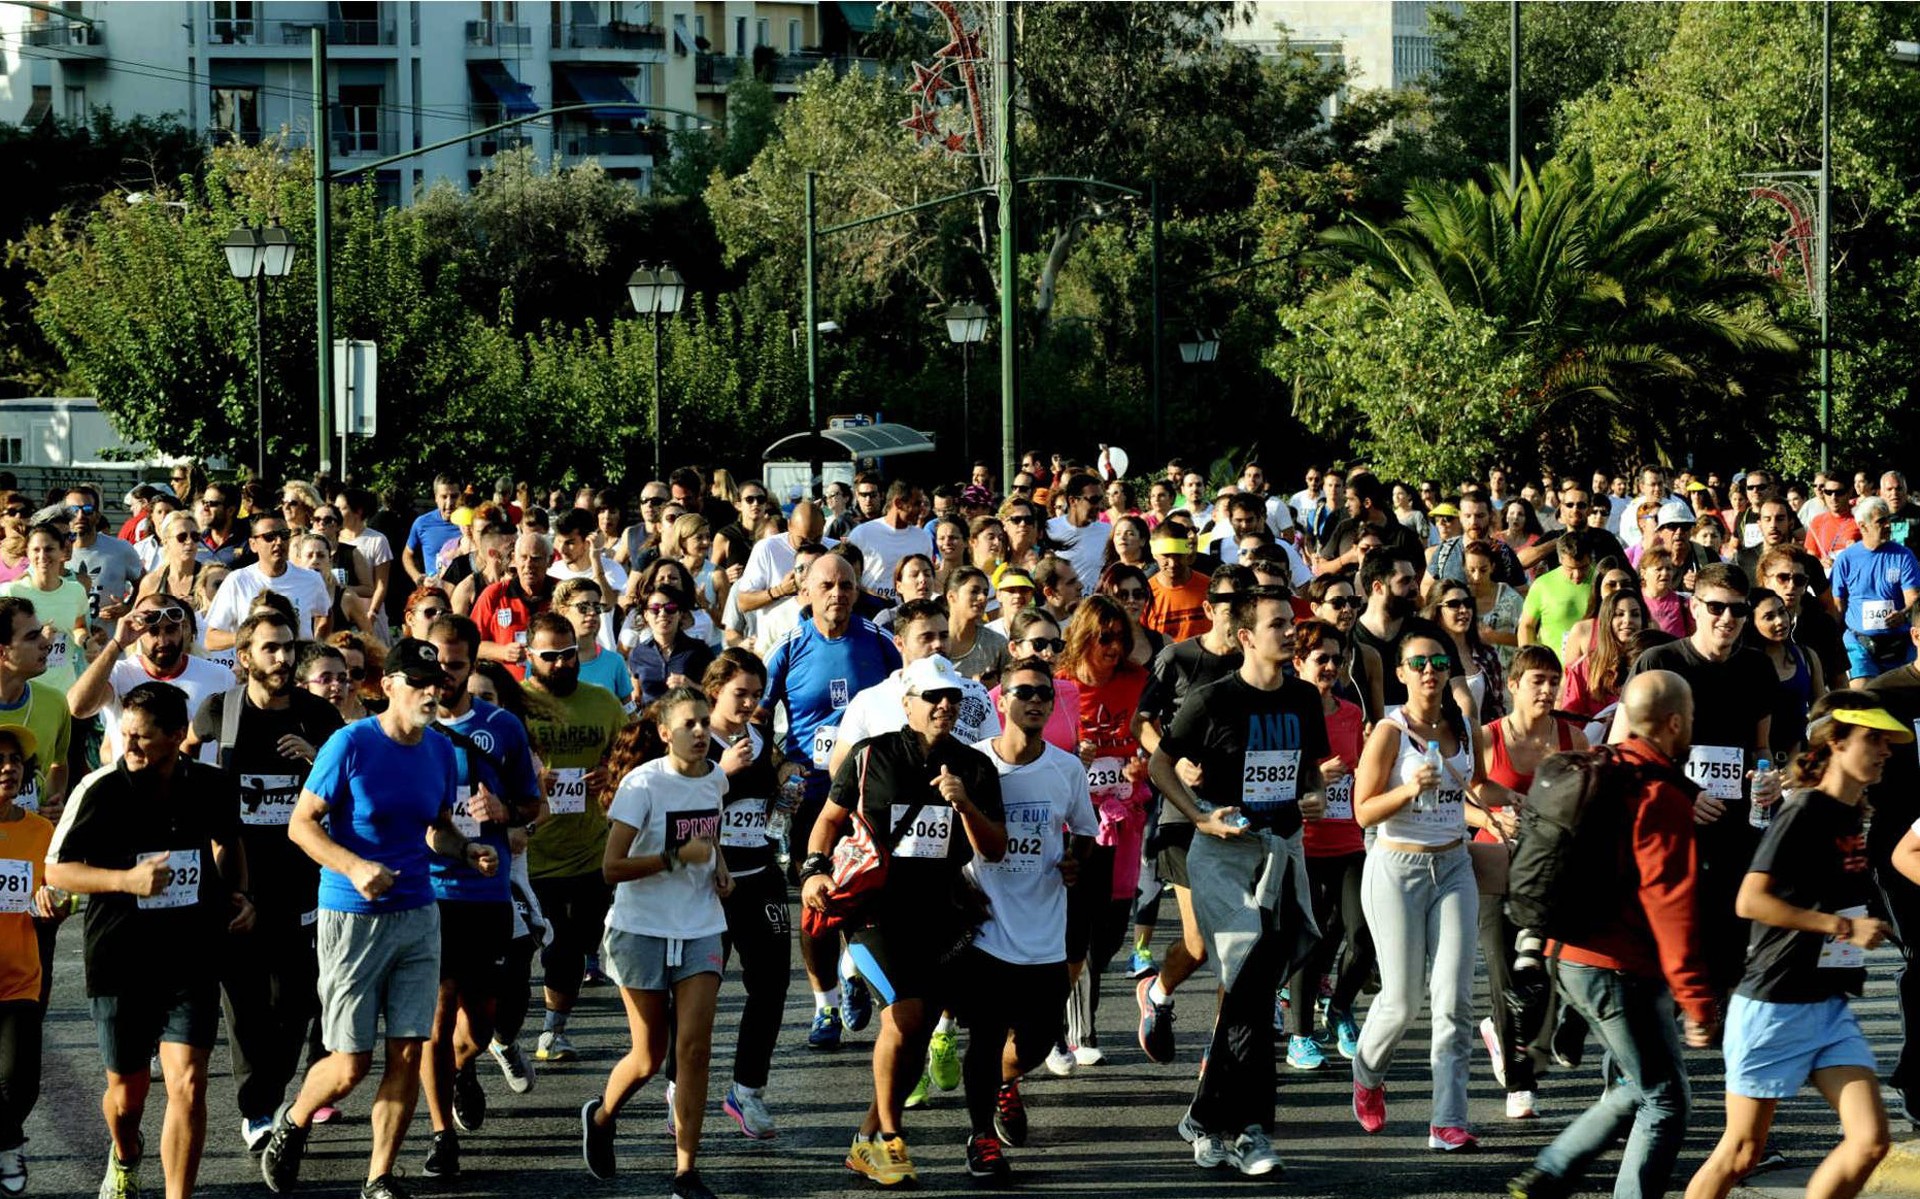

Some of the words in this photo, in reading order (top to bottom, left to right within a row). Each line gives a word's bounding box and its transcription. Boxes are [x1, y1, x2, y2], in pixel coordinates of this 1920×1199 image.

[1865, 609, 1893, 620] 340
[1247, 712, 1301, 751] AND
[815, 738, 836, 753] 09
[1245, 765, 1296, 783] 25832
[1689, 761, 1741, 780] 17555
[1325, 786, 1349, 803] 363
[1022, 808, 1049, 823] RUN
[1007, 837, 1041, 856] 062
